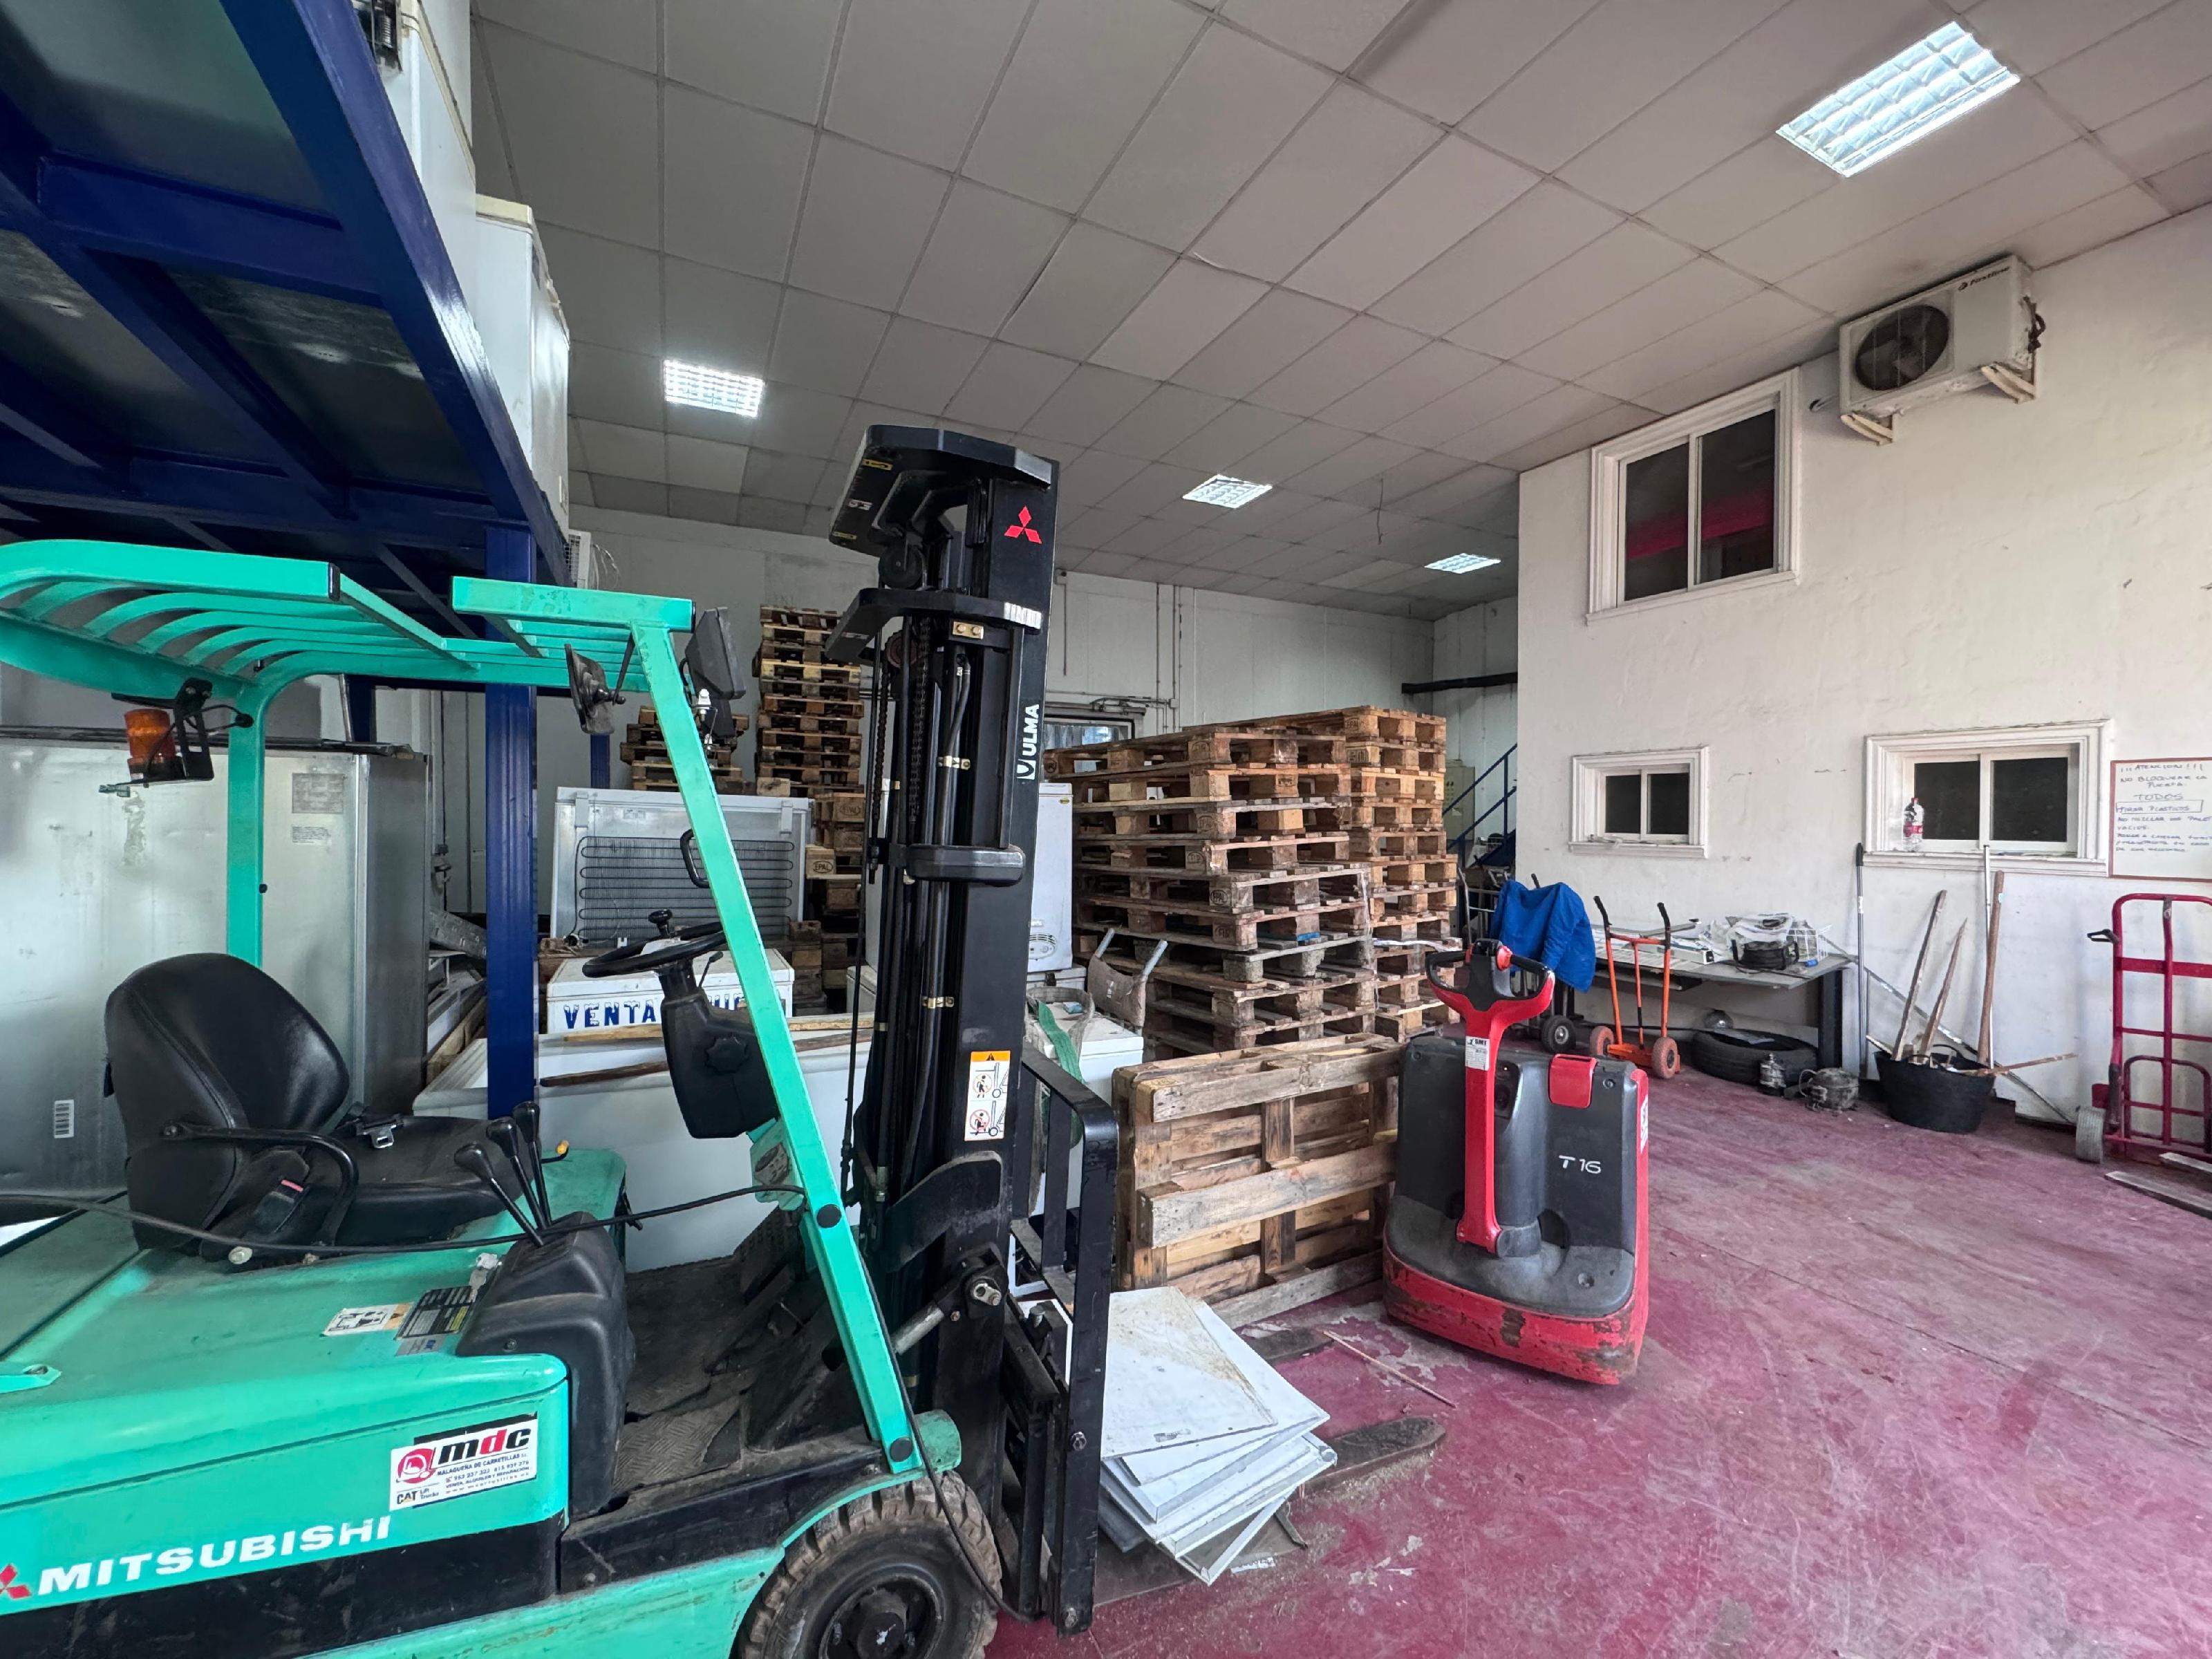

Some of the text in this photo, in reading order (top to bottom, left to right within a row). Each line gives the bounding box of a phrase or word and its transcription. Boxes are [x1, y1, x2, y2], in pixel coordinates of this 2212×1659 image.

[1022, 704, 1039, 756] ULMA
[2133, 793, 2184, 801] TODOS
[563, 999, 657, 1029] VENTA
[438, 1428, 531, 1465] mdc
[437, 1464, 472, 1476] MALAGUEÑA
[482, 1454, 520, 1466] CARRETILLAS
[397, 1490, 418, 1505] CAT
[38, 1515, 391, 1595] MITSUBISHI
